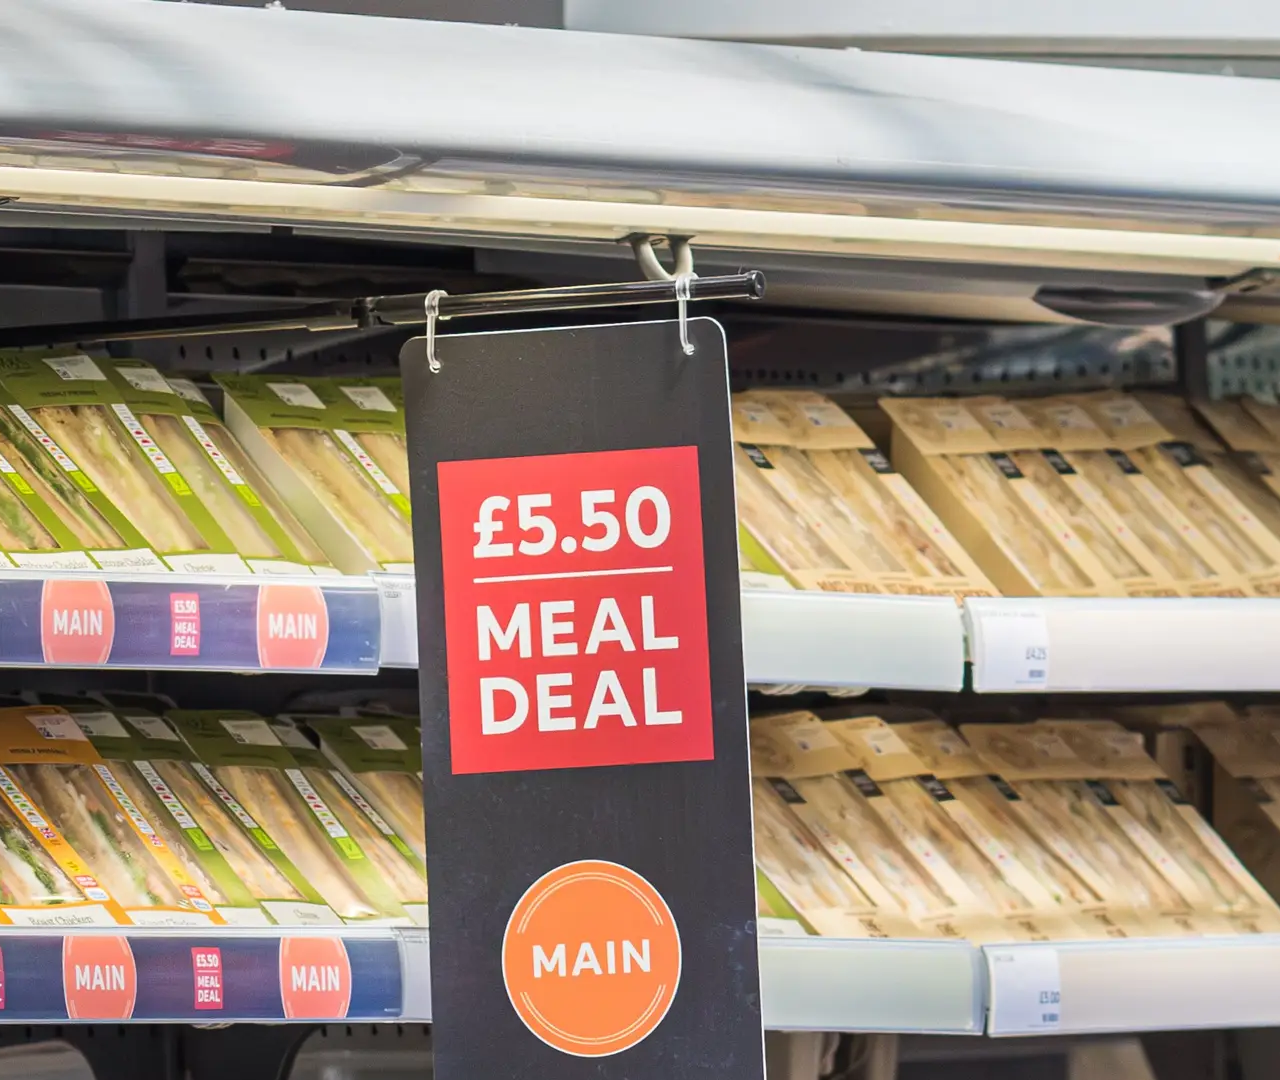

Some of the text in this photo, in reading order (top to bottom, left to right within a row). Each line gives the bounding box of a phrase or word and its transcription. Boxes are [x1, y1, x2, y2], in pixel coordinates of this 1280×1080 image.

[473, 486, 672, 559] £5.50
[174, 600, 197, 614] £5.50
[53, 609, 102, 636] MAIN
[174, 622, 198, 634] MEAL
[268, 614, 317, 639] MAIN
[477, 595, 679, 661] MEAL
[174, 635, 197, 649] DEAL
[480, 668, 682, 735] DEAL
[196, 953, 219, 968] £5.50
[532, 939, 651, 979] MAIN
[75, 965, 125, 991] MAIN
[198, 975, 220, 988] MEAL
[292, 965, 340, 992] MAIN
[198, 990, 220, 1003] DEAL
